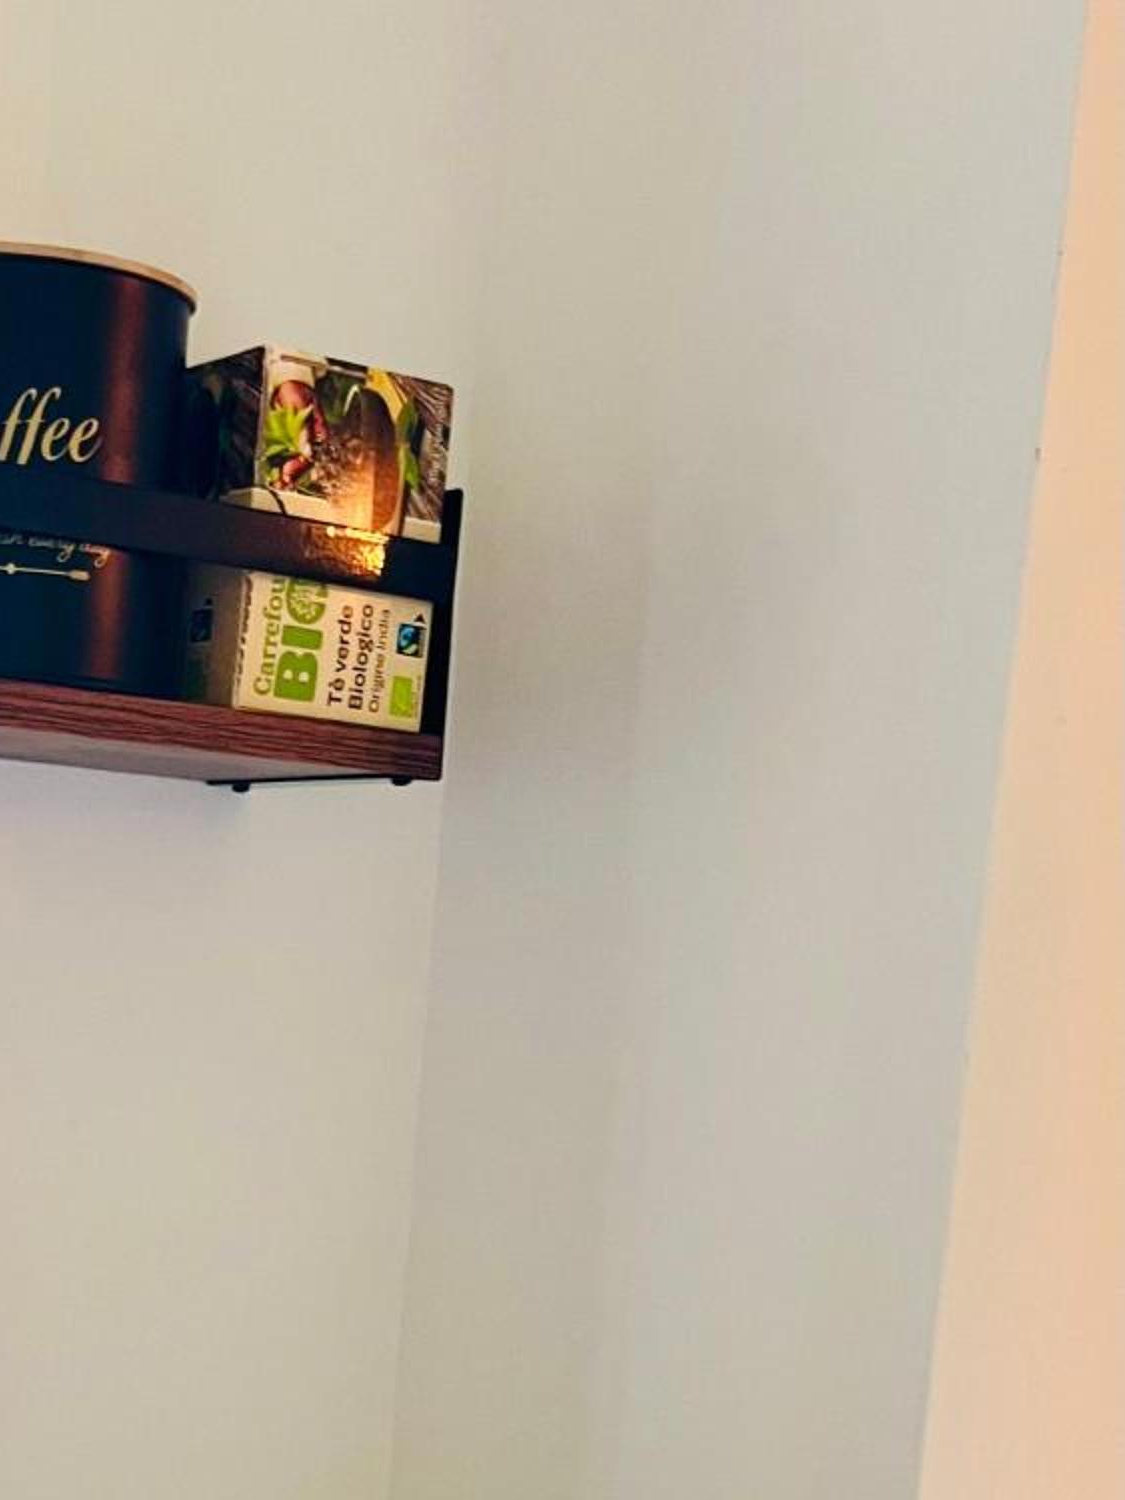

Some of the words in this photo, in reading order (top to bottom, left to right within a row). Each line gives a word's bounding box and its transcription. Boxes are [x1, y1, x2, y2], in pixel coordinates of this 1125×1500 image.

[253, 577, 286, 696] Carrefou
[334, 604, 354, 673] verde
[348, 603, 375, 711] Biologico
[374, 608, 391, 651] India
[369, 653, 387, 713] Origine
